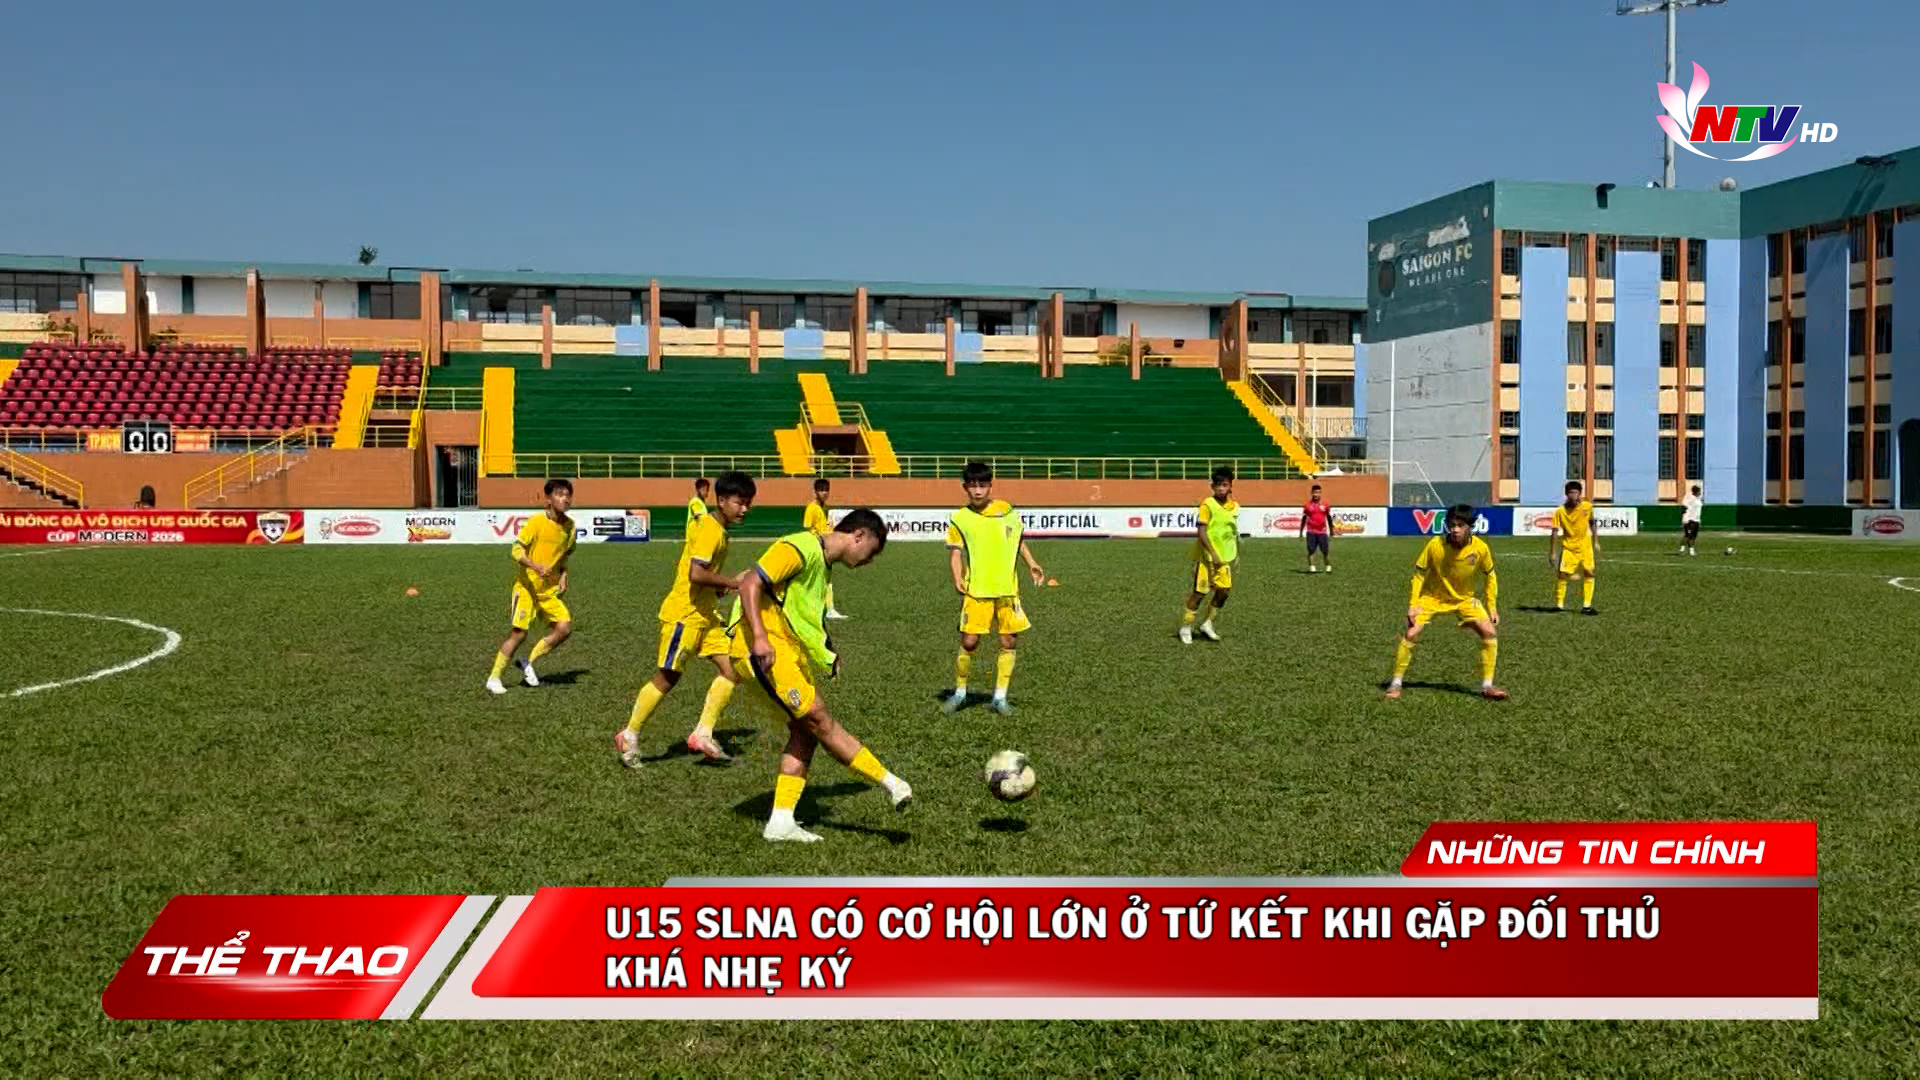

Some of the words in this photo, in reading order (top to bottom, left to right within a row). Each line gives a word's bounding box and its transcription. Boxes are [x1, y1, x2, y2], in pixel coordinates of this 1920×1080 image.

[1402, 249, 1451, 276] SAIGON
[1455, 243, 1473, 263] FC
[1446, 265, 1465, 279] ONE
[129, 431, 144, 452] 0
[153, 432, 168, 452] 0
[14, 513, 59, 527] BÓNG
[86, 513, 109, 527] VÔ
[177, 511, 220, 528] QUỐC
[222, 515, 248, 528] GIA
[1021, 514, 1100, 529] FF.OFFICIAL
[1150, 513, 1174, 528] VFF
[79, 531, 147, 541] MODERN
